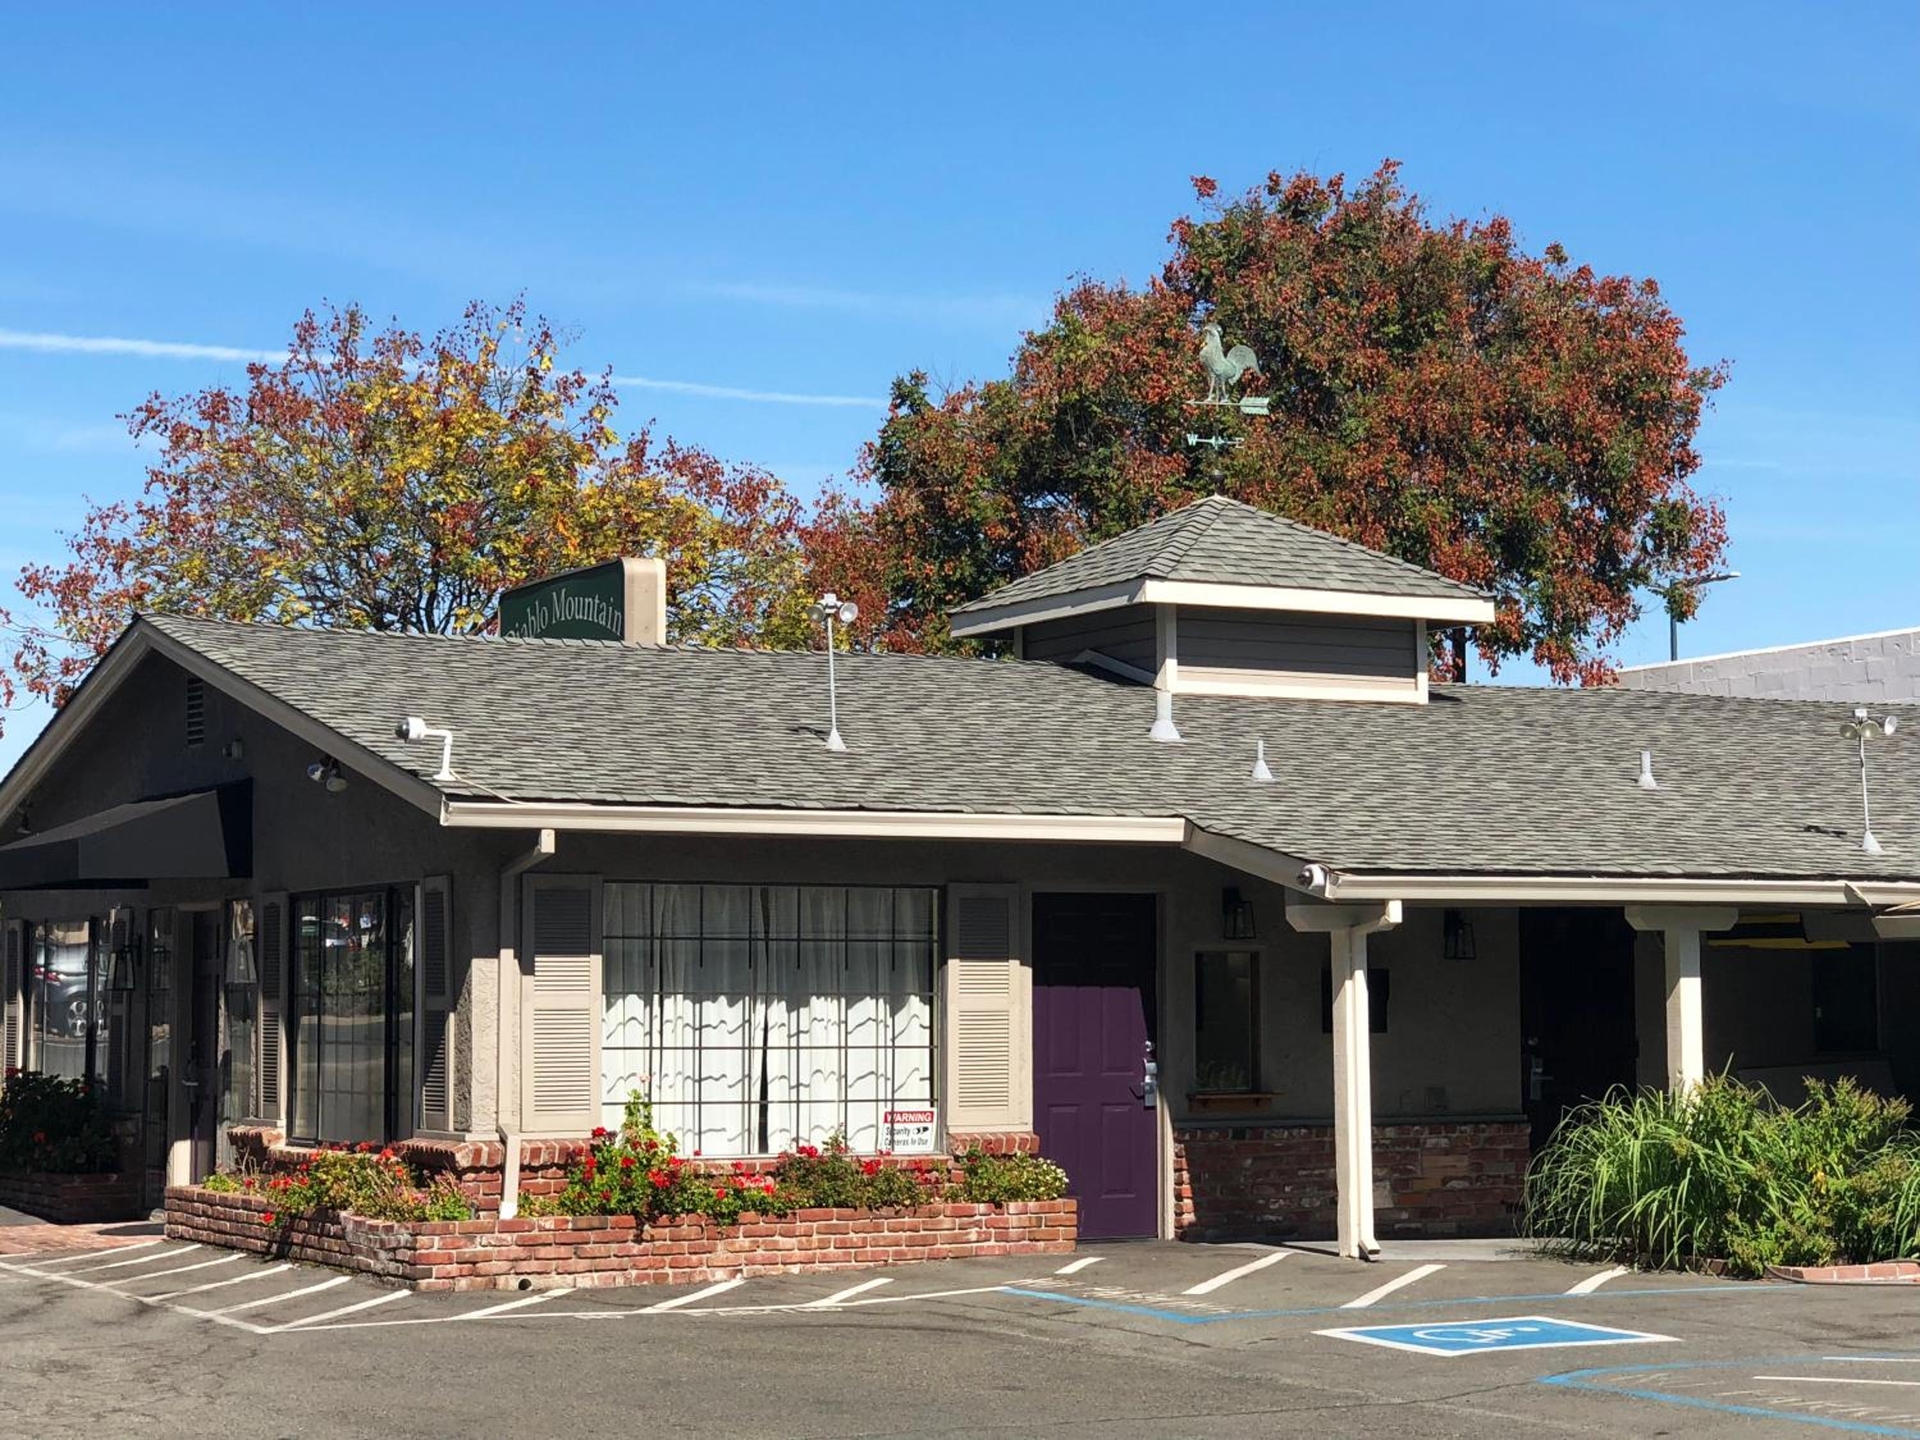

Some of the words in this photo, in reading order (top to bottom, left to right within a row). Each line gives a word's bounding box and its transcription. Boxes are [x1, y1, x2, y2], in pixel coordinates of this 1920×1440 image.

[1186, 432, 1199, 446] W
[551, 588, 622, 636] Mountain
[886, 1112, 932, 1122] WARNING
[885, 1126, 911, 1137] Scurity
